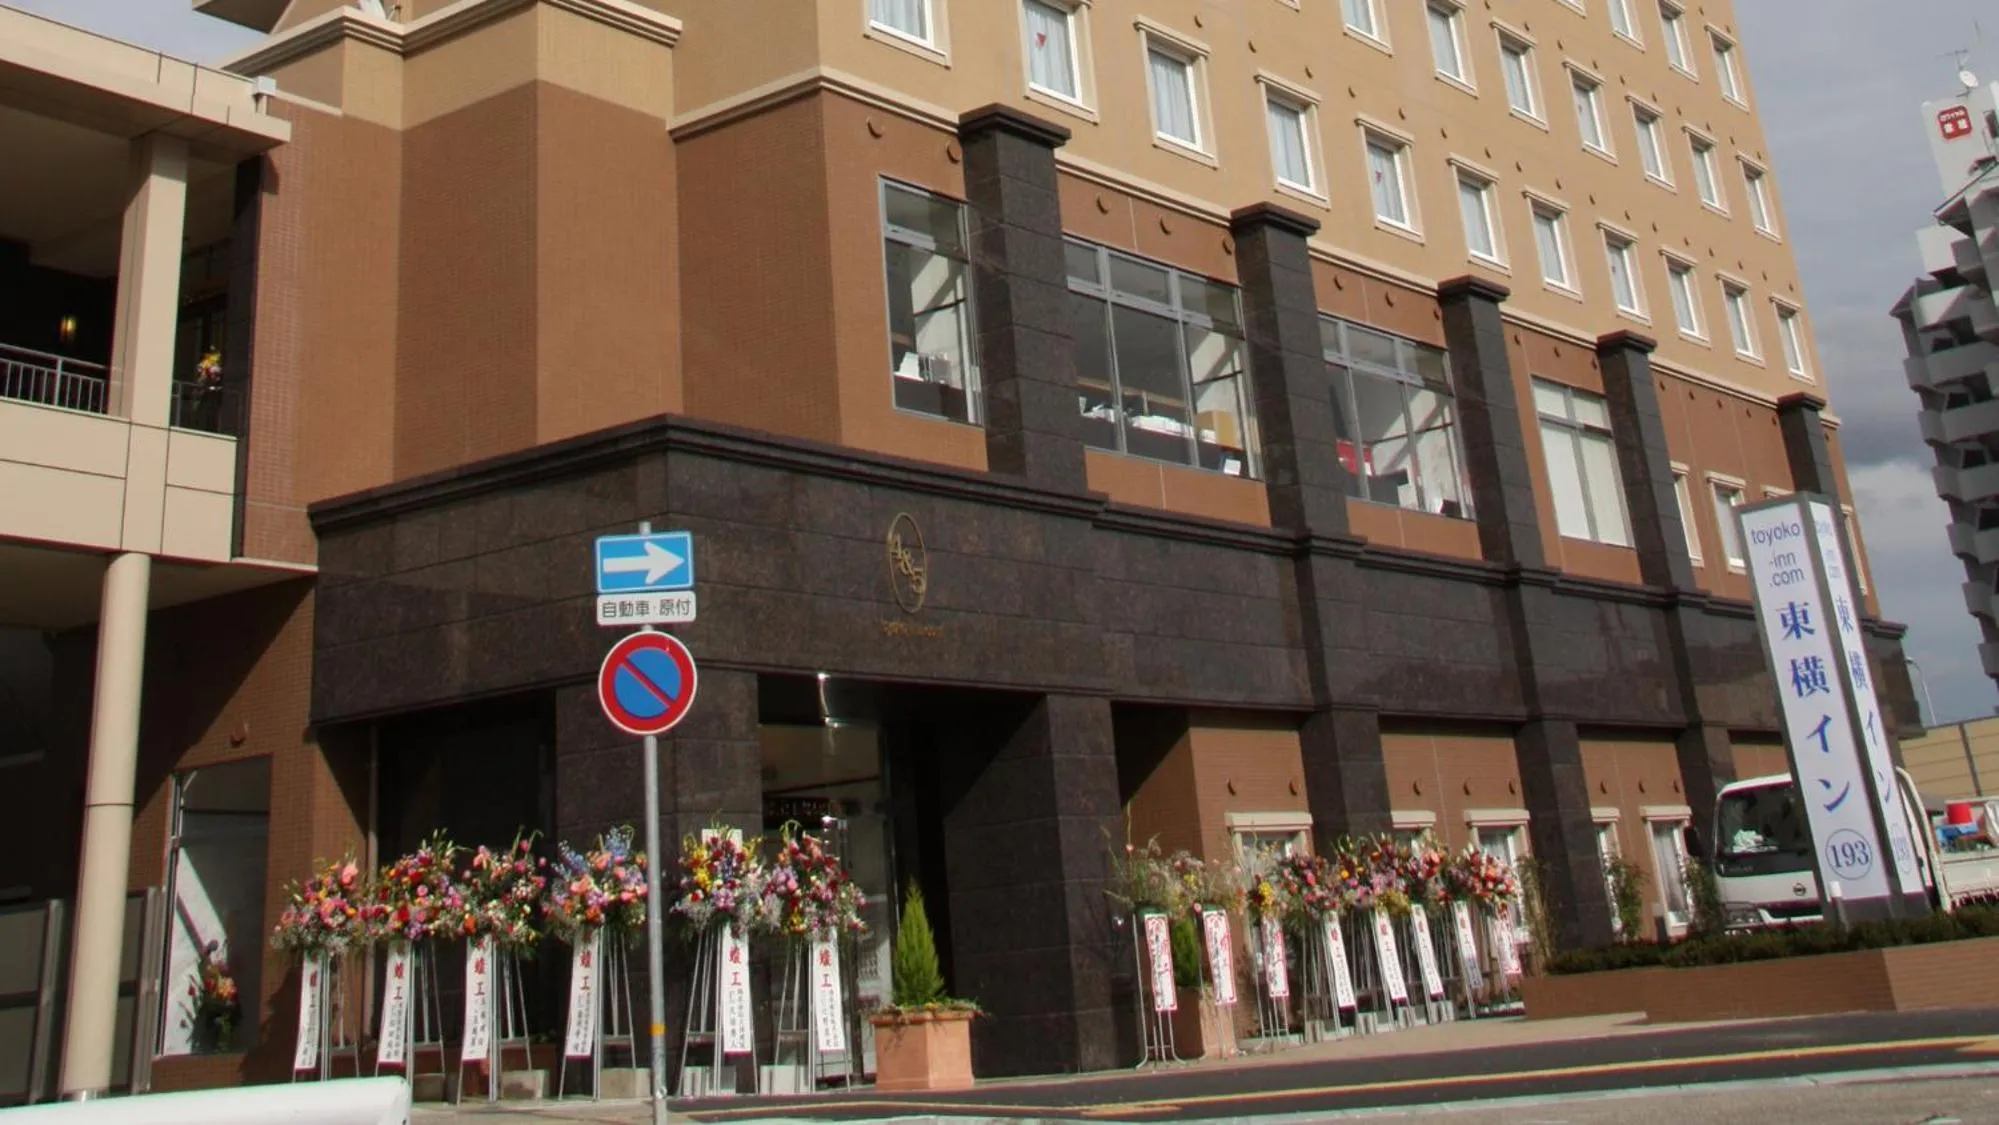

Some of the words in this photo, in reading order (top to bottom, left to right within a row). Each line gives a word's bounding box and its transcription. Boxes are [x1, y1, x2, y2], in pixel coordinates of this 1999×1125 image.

[1750, 522, 1801, 546] toyoko
[1769, 567, 1805, 588] .com
[1776, 601, 1850, 812] 東横イン
[1831, 840, 1869, 868] 193
